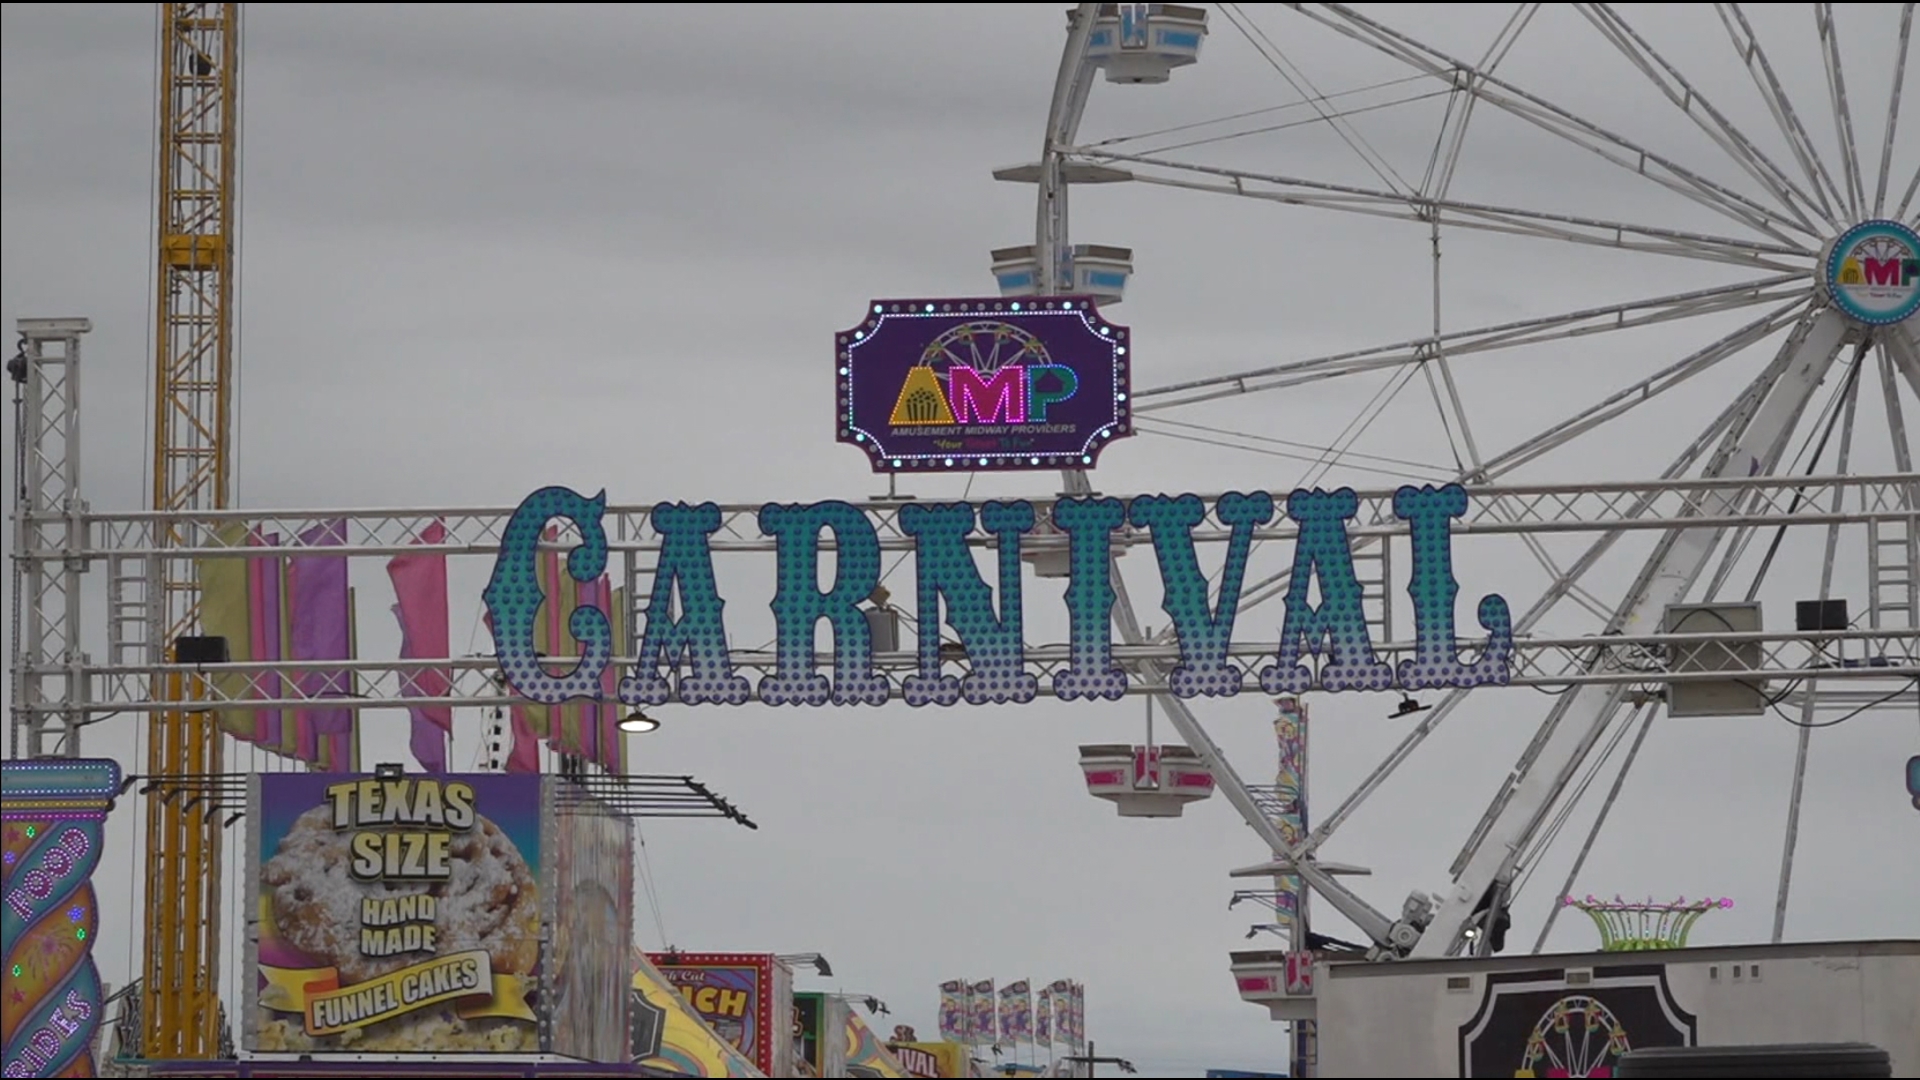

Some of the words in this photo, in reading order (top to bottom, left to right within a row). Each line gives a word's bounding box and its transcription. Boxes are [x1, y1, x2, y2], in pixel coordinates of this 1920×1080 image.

[1836, 256, 1919, 286] AMP
[888, 363, 1078, 425] AMP
[890, 425, 963, 437] AMUSEMENT
[964, 425, 1009, 436] MIDWAY
[1010, 423, 1077, 435] PROVIDERS
[482, 483, 1515, 706] CARNIVAL
[327, 778, 476, 830] TEXAS
[5, 827, 90, 922] FOOD
[352, 832, 451, 879] SIZE
[362, 894, 436, 925] HAND
[361, 924, 437, 956] MADE
[313, 981, 398, 1029] FUNNEL
[402, 958, 480, 1004] CAKES
[681, 970, 706, 982] Cut
[897, 1048, 939, 1078] IVAL
